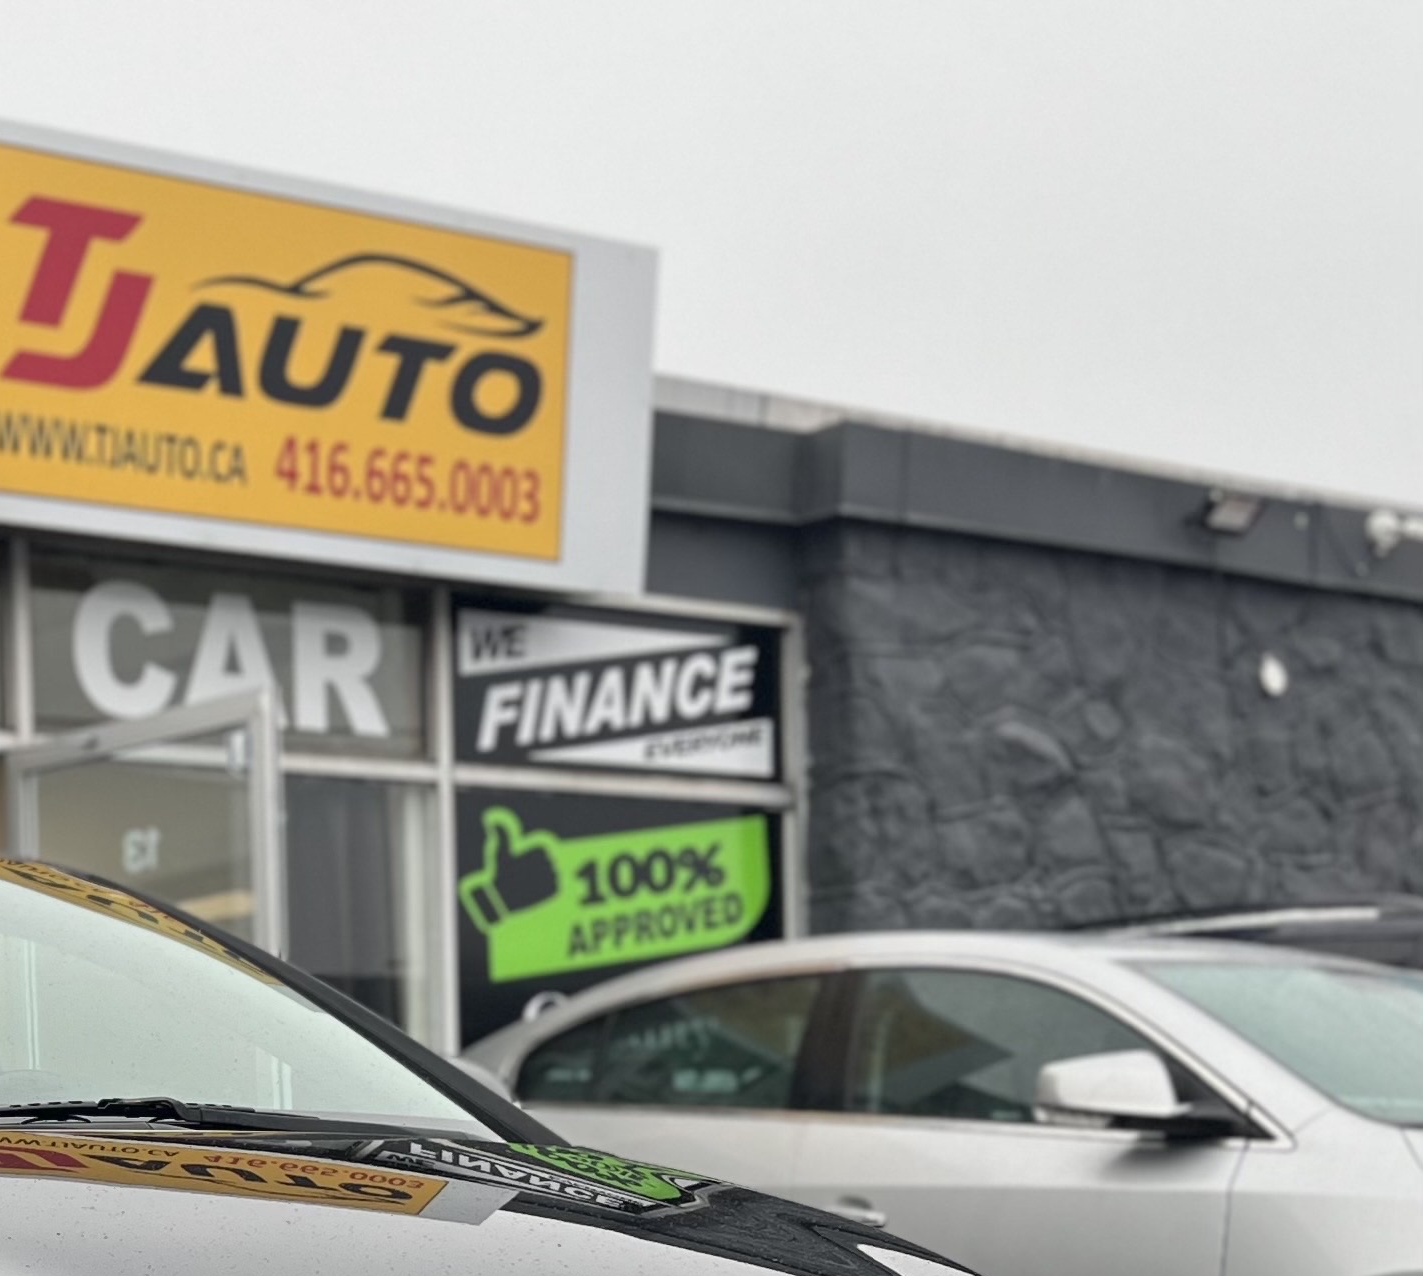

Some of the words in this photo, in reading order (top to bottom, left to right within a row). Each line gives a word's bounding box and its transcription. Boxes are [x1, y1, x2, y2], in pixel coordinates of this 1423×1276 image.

[136, 303, 545, 437] AUTO
[275, 435, 540, 524] 416.665.0003
[73, 579, 389, 737] CAR
[470, 622, 526, 660] WE
[477, 644, 759, 753] FINANCE
[575, 840, 725, 906] 100%
[566, 892, 746, 958] APPROVED
